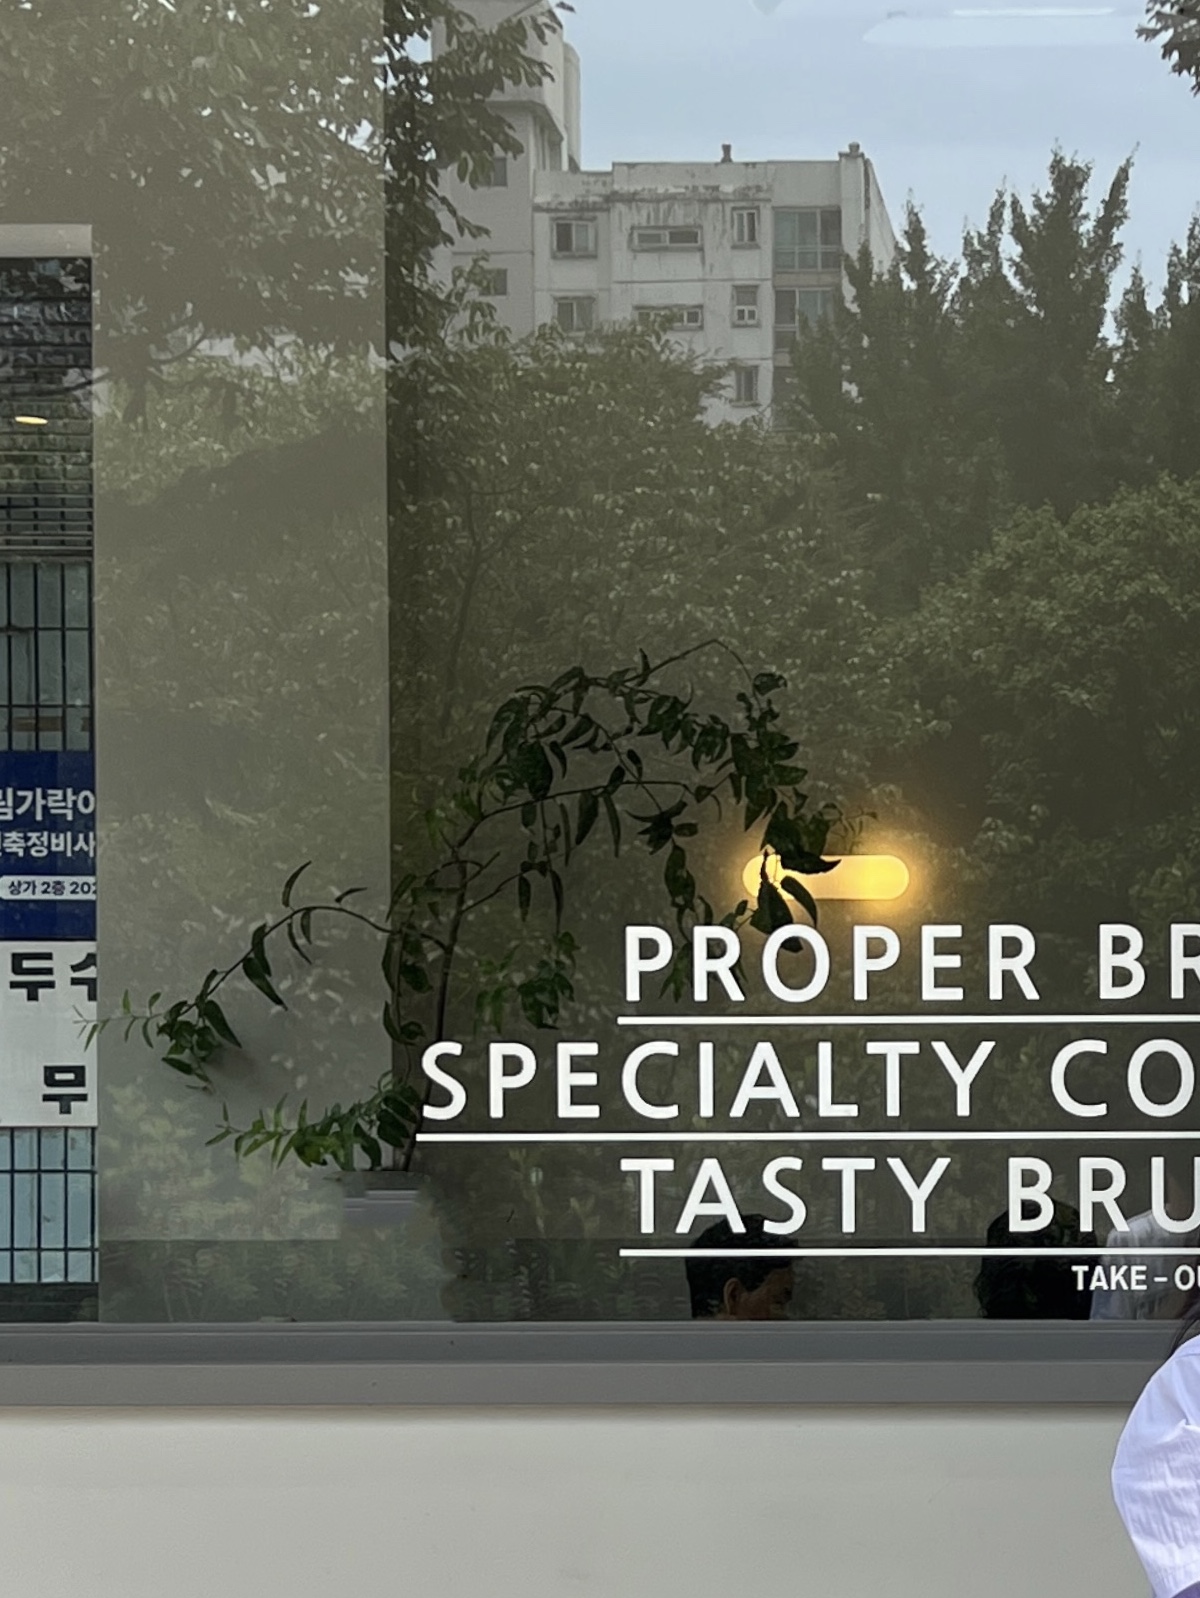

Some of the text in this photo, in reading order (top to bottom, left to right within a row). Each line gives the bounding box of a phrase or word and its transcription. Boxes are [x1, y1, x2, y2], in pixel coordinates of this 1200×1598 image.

[0, 831, 95, 858] 축정비사
[9, 880, 36, 896] 상가
[41, 880, 65, 896] 2층
[625, 924, 1040, 1003] PROPER
[42, 1065, 88, 1115] 무
[421, 1040, 996, 1120] SPECIALTY
[620, 1156, 951, 1235] TASTY
